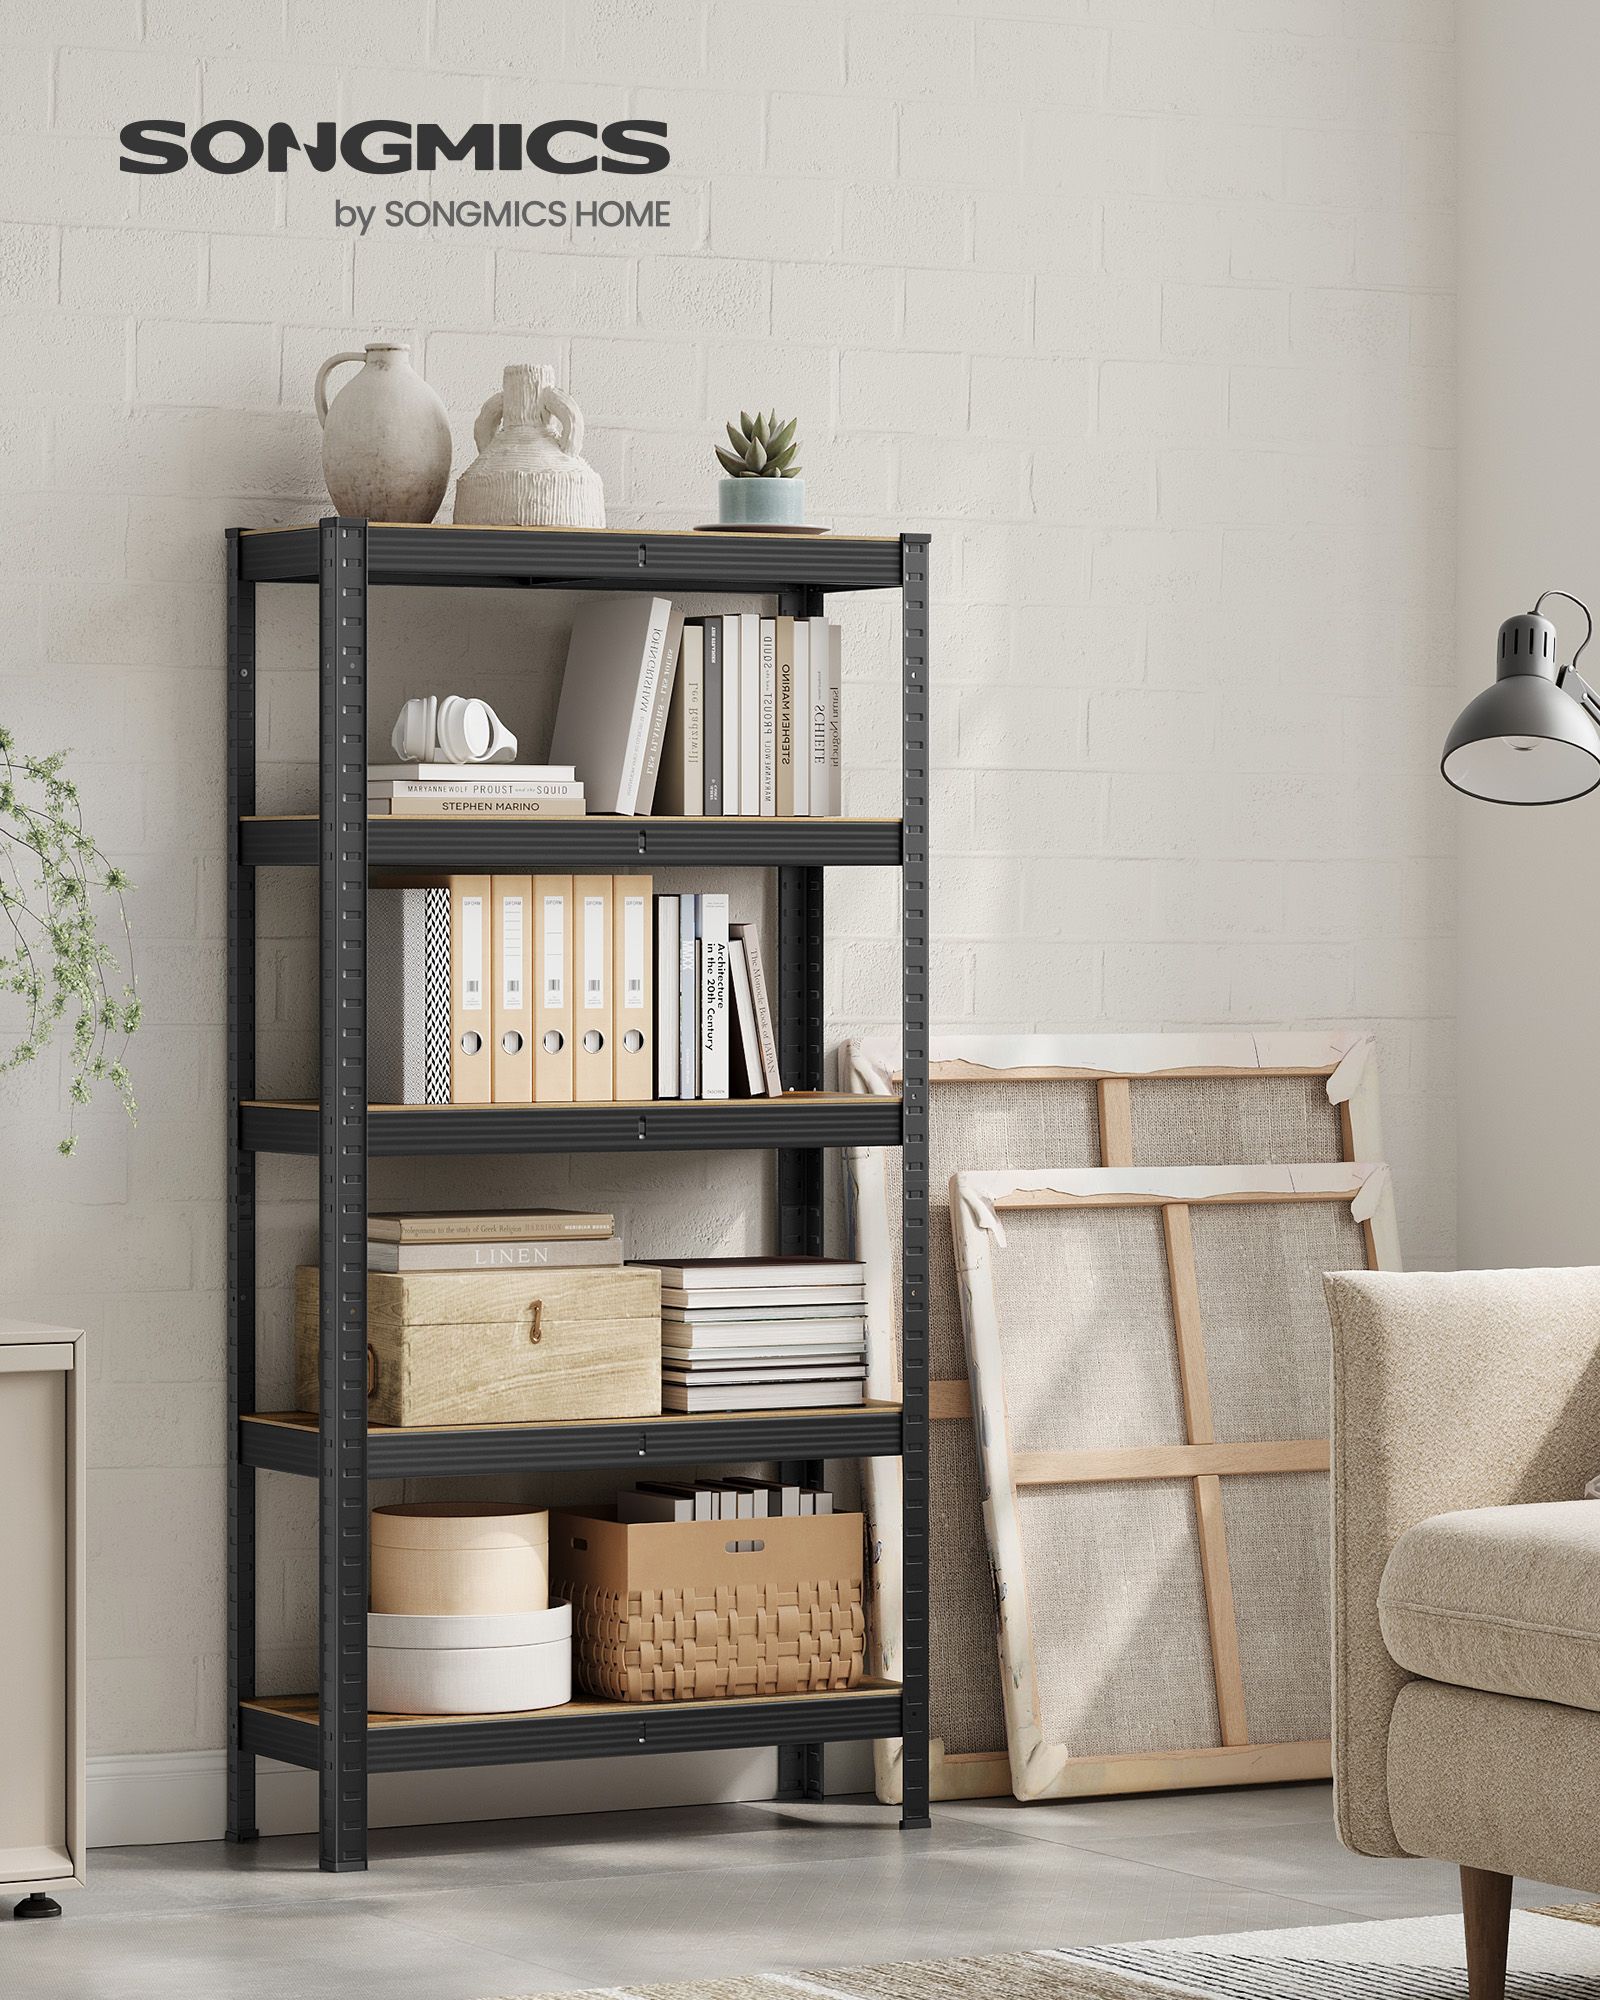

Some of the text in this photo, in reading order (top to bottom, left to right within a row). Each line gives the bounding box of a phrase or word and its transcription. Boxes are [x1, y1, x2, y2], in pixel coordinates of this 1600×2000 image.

[407, 785, 447, 793] MARYANNE
[449, 785, 468, 793] WOLF
[473, 785, 513, 795] PROUST
[536, 785, 568, 795] SQUID
[442, 802, 540, 811] STEPHEN MARINO
[717, 943, 726, 1008] Architecture
[704, 943, 716, 1051] in the 20th Century
[758, 1007, 769, 1029] Book
[763, 1042, 776, 1074] JAPAN
[475, 1247, 549, 1265] LINEN
